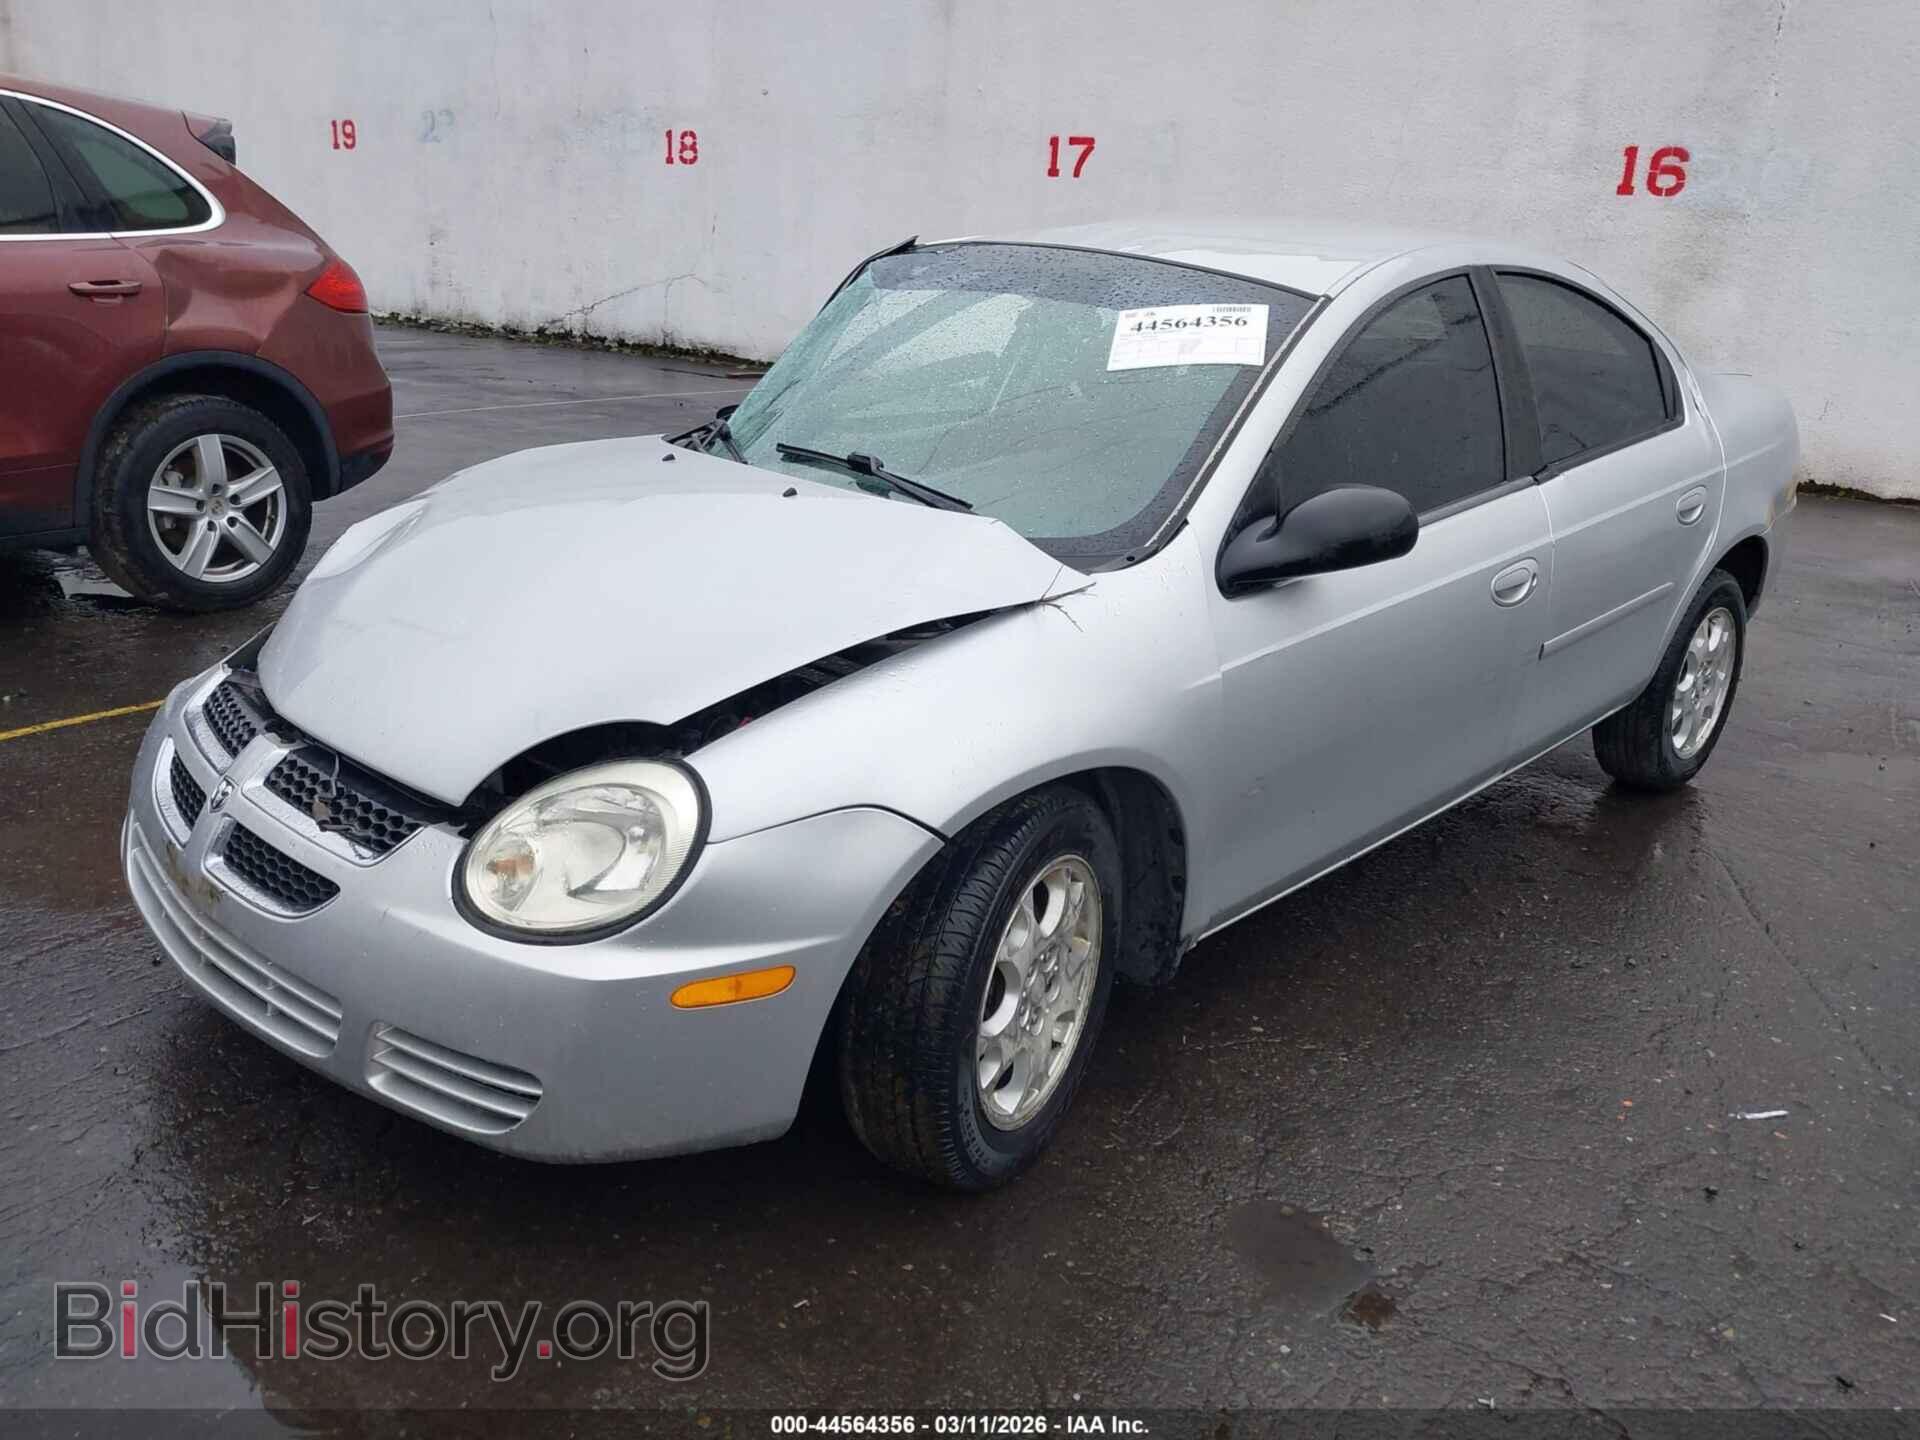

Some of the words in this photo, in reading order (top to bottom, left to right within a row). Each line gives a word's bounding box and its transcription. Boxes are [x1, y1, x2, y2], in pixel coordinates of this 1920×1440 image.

[331, 119, 357, 150] 19
[665, 129, 699, 166] 18
[1046, 135, 1096, 178] 17
[1616, 145, 1690, 198] 16
[1130, 315, 1249, 333] 44564356
